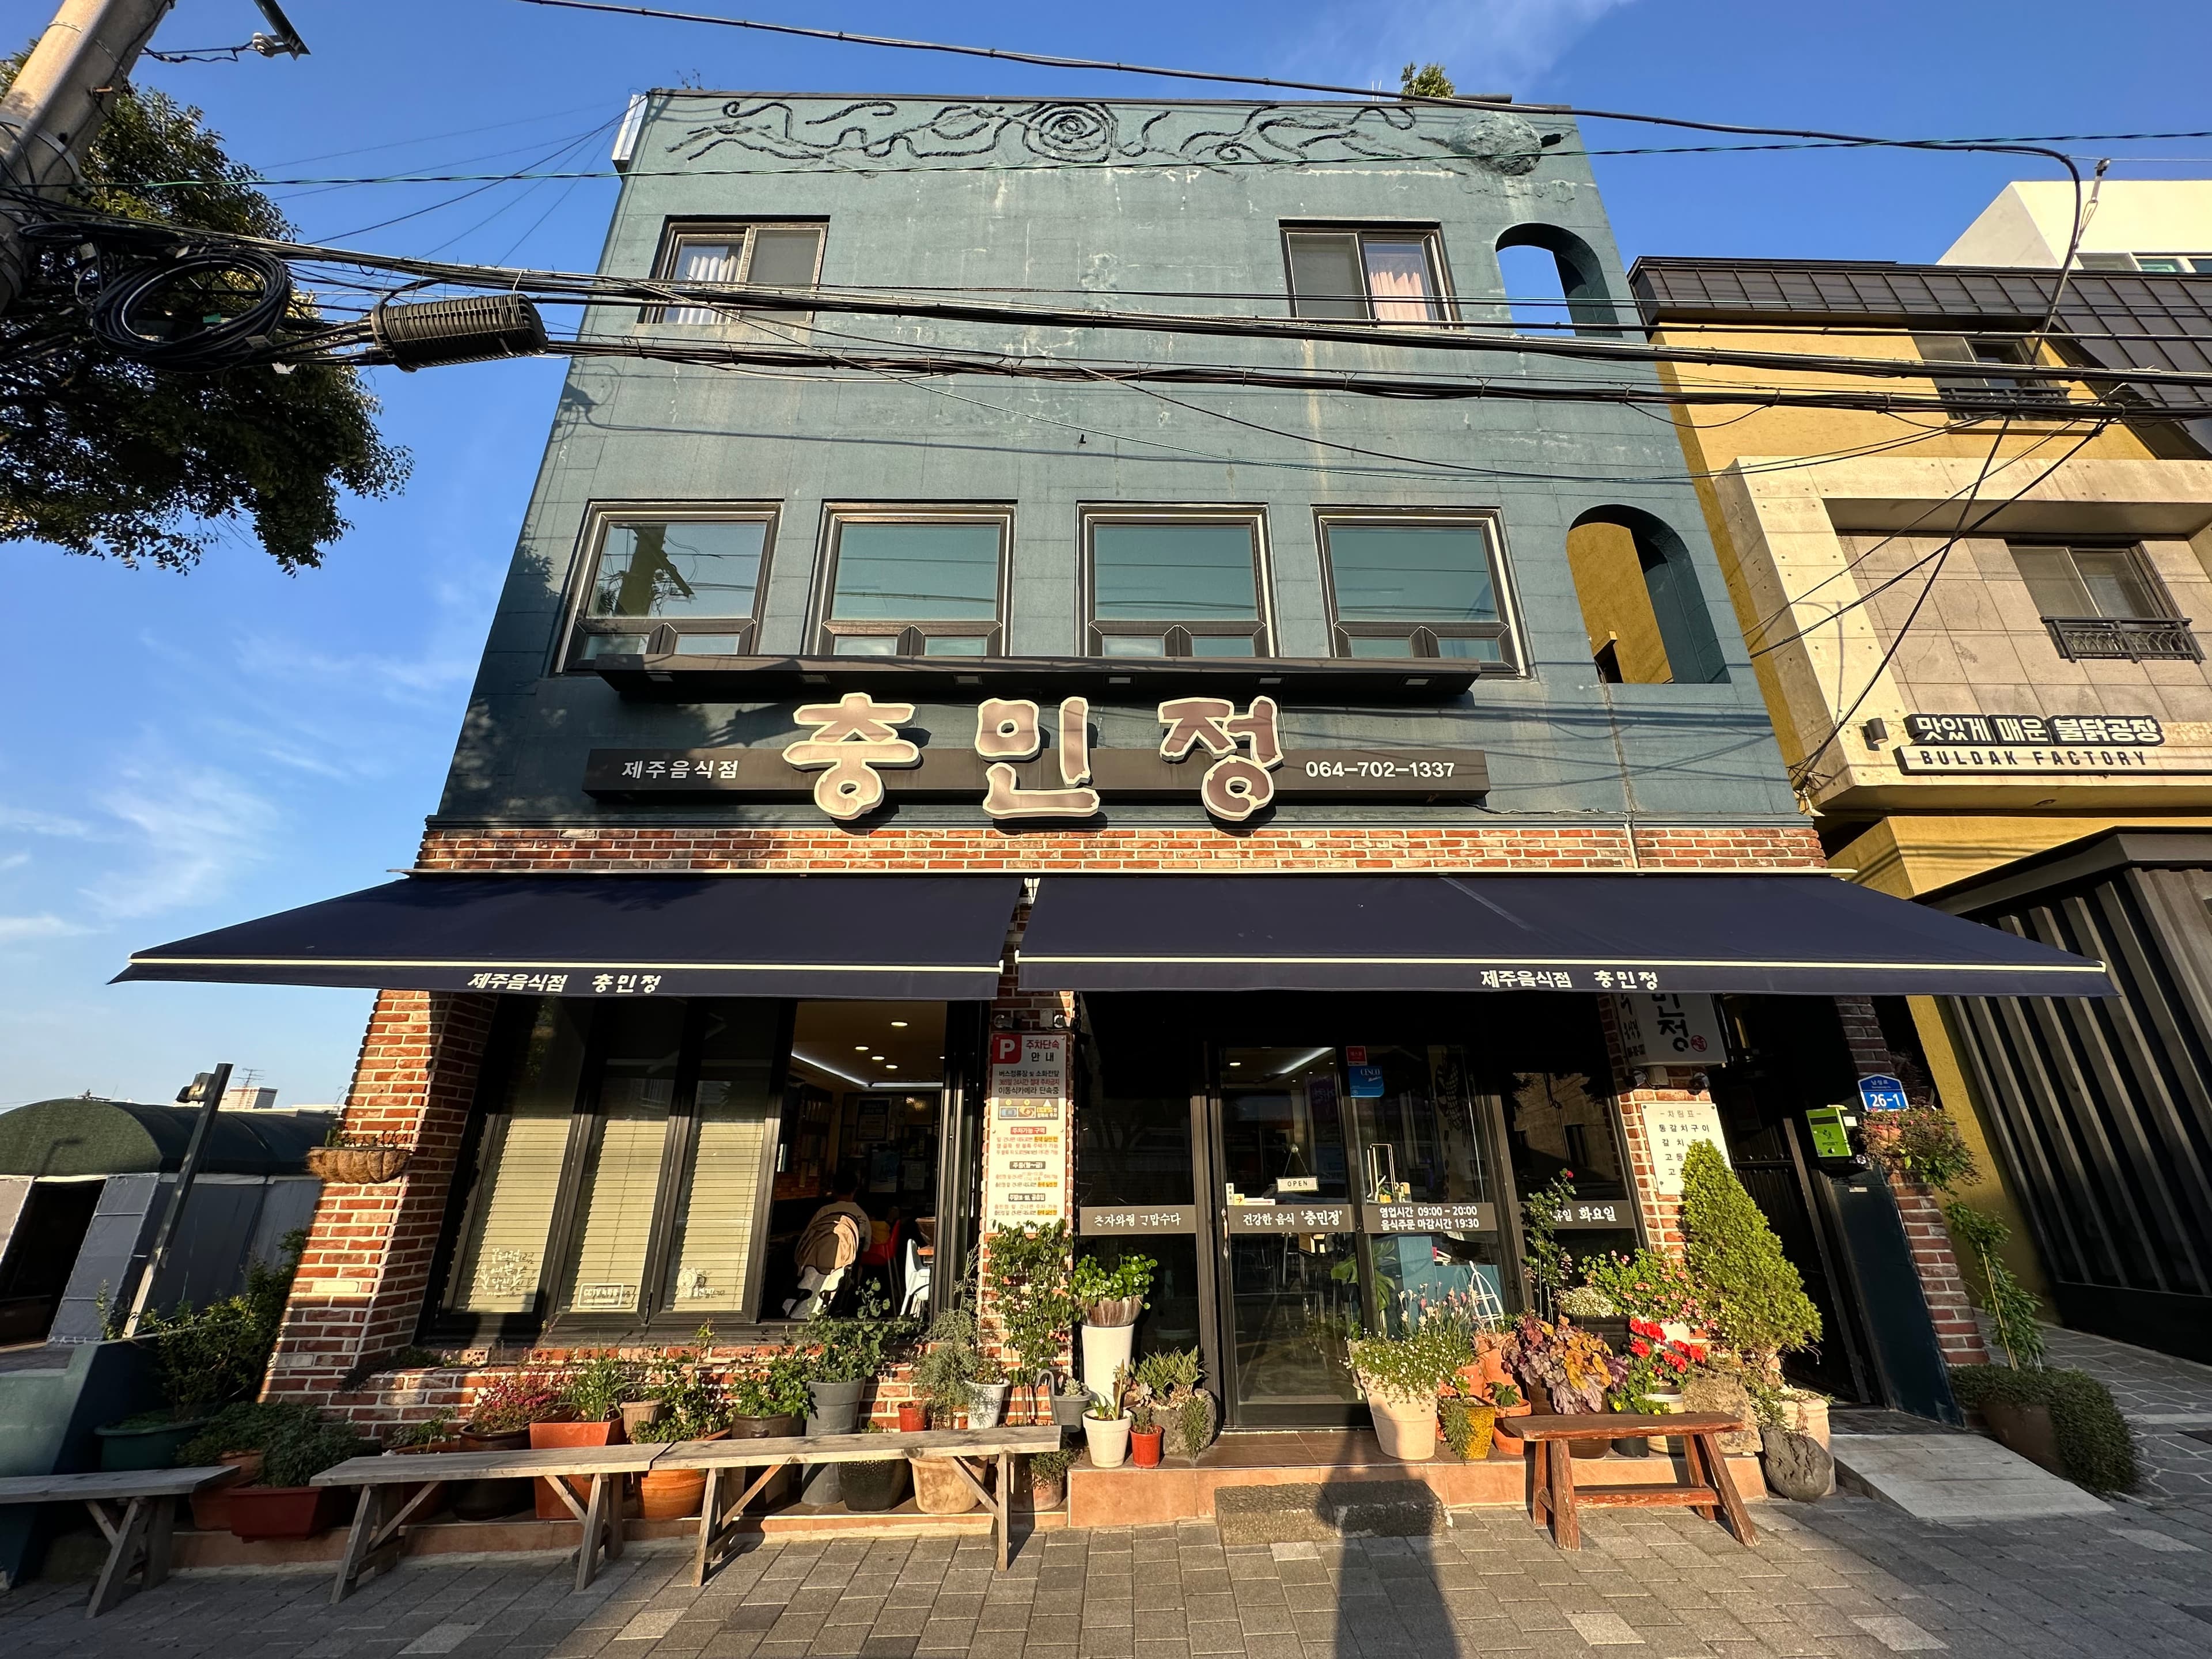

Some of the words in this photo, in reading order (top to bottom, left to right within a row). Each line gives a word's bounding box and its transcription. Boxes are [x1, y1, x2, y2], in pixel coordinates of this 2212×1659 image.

[1916, 717, 1992, 741] 맛있게
[1995, 718, 2048, 742] 매운
[2054, 718, 2161, 743] 불닭공장
[782, 692, 1285, 821] 충민정
[1919, 751, 2018, 765] BULDAK
[2032, 751, 2146, 766] FACTORY
[622, 760, 738, 779] 제주음식점
[1305, 761, 1455, 778] 064-702-1337
[467, 972, 569, 993] 제주음식점
[592, 973, 662, 994] 충민정
[1480, 969, 1573, 989] 제주음식점
[1593, 969, 1658, 990] 충민정
[999, 1039, 1016, 1059] P
[1025, 1039, 1060, 1050] 주차단속
[998, 1086, 1037, 1095] 이동식카메라
[1039, 1086, 1060, 1095] 단속중
[1870, 1093, 1901, 1107] 26-1
[1243, 1213, 1272, 1226] 건강한
[1275, 1213, 1296, 1226] 음식
[1379, 1206, 1414, 1218] 영업시간
[1418, 1206, 1443, 1217] 09:00
[1452, 1206, 1478, 1216] 20:00
[1578, 1206, 1617, 1222] 화요일
[1381, 1219, 1415, 1230] 음식주문
[1417, 1218, 1452, 1230] 마감시간
[1455, 1218, 1479, 1228] 19:30
